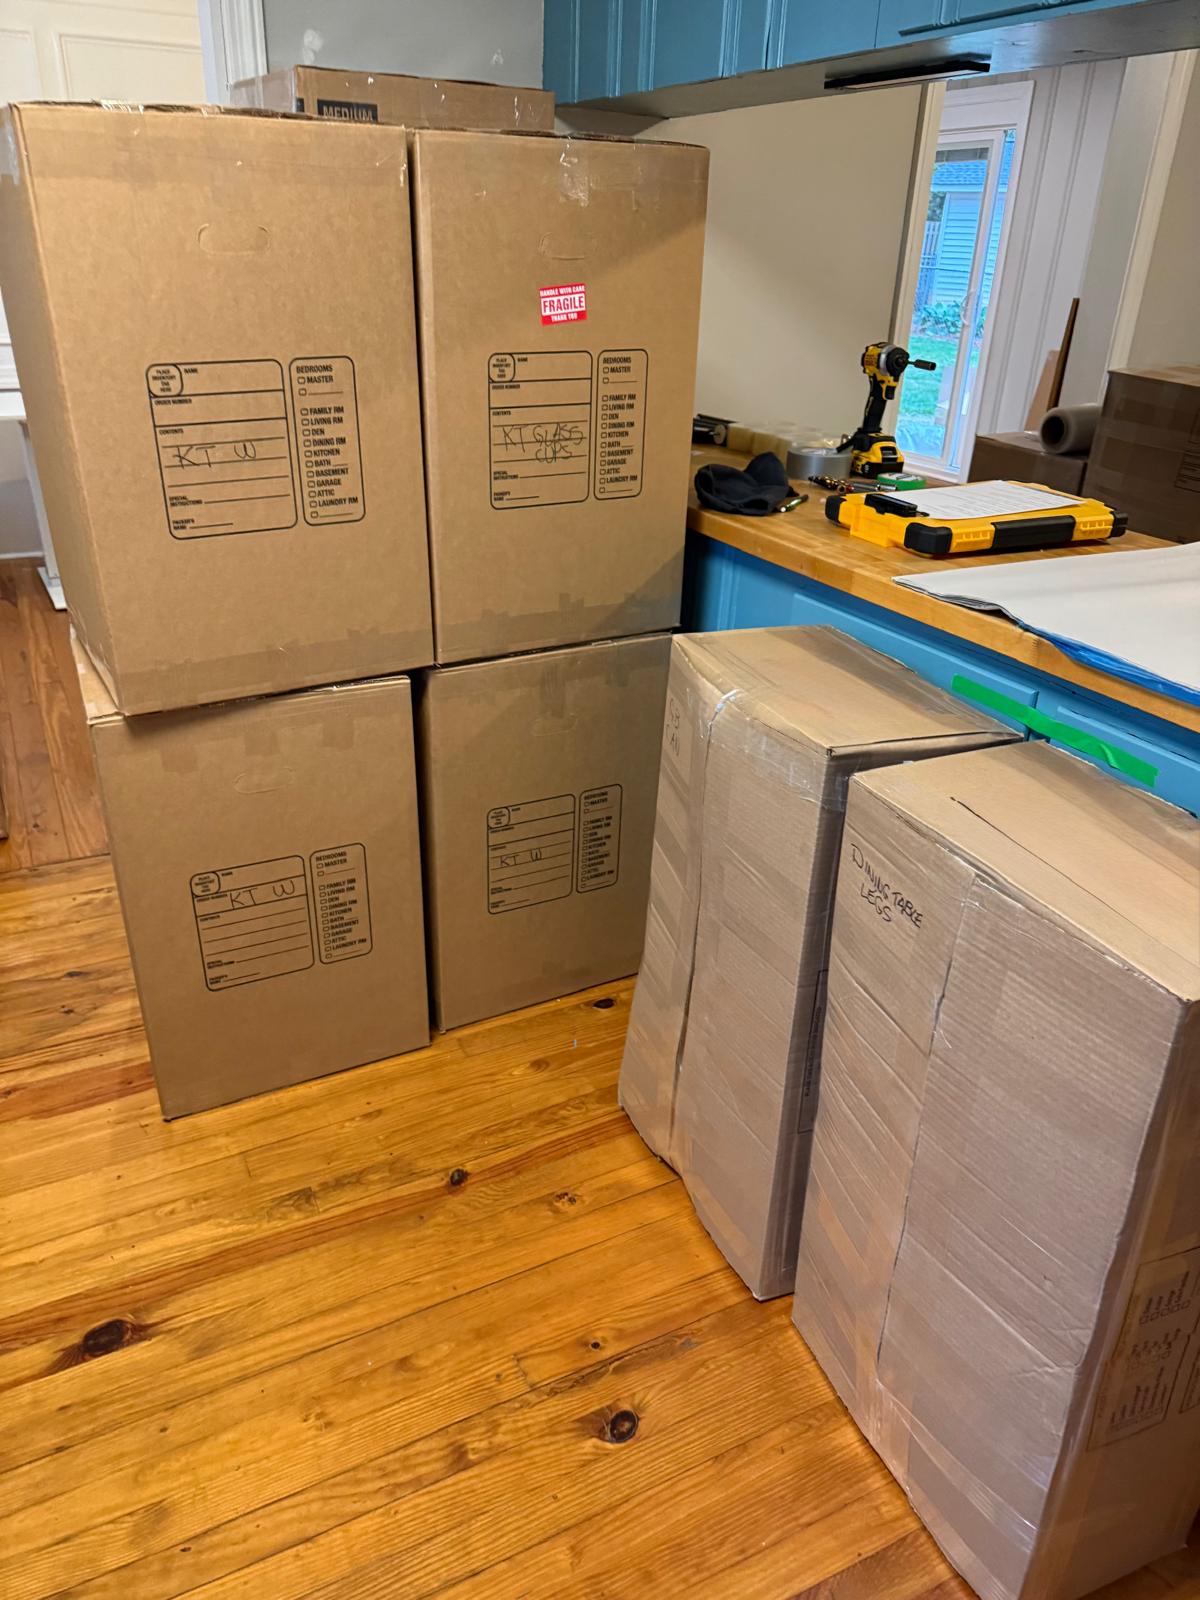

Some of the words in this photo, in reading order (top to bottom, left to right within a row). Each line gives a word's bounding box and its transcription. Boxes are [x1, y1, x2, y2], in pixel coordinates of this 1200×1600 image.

[323, 105, 374, 121] MEDIUM
[543, 296, 585, 313] FRAGILE
[296, 365, 333, 373] BEDROOMS
[306, 375, 334, 384] MASTER
[309, 407, 332, 415] FAMILY
[333, 406, 345, 414] RM
[310, 418, 332, 426] LIVING
[332, 416, 344, 424] RM
[311, 428, 325, 436] DEN
[312, 438, 334, 447] DINING
[335, 437, 347, 445] RM
[313, 448, 340, 457] KITCHEN
[314, 459, 331, 467] BATH
[315, 468, 349, 477] BASEMENT
[316, 479, 342, 487] GARAGE
[317, 489, 335, 497] ATTIC
[318, 498, 346, 507] LAUNDRY
[348, 496, 359, 504] RM
[229, 888, 258, 910] KT
[861, 883, 892, 922] LEGS
[892, 892, 923, 928] TABLE
